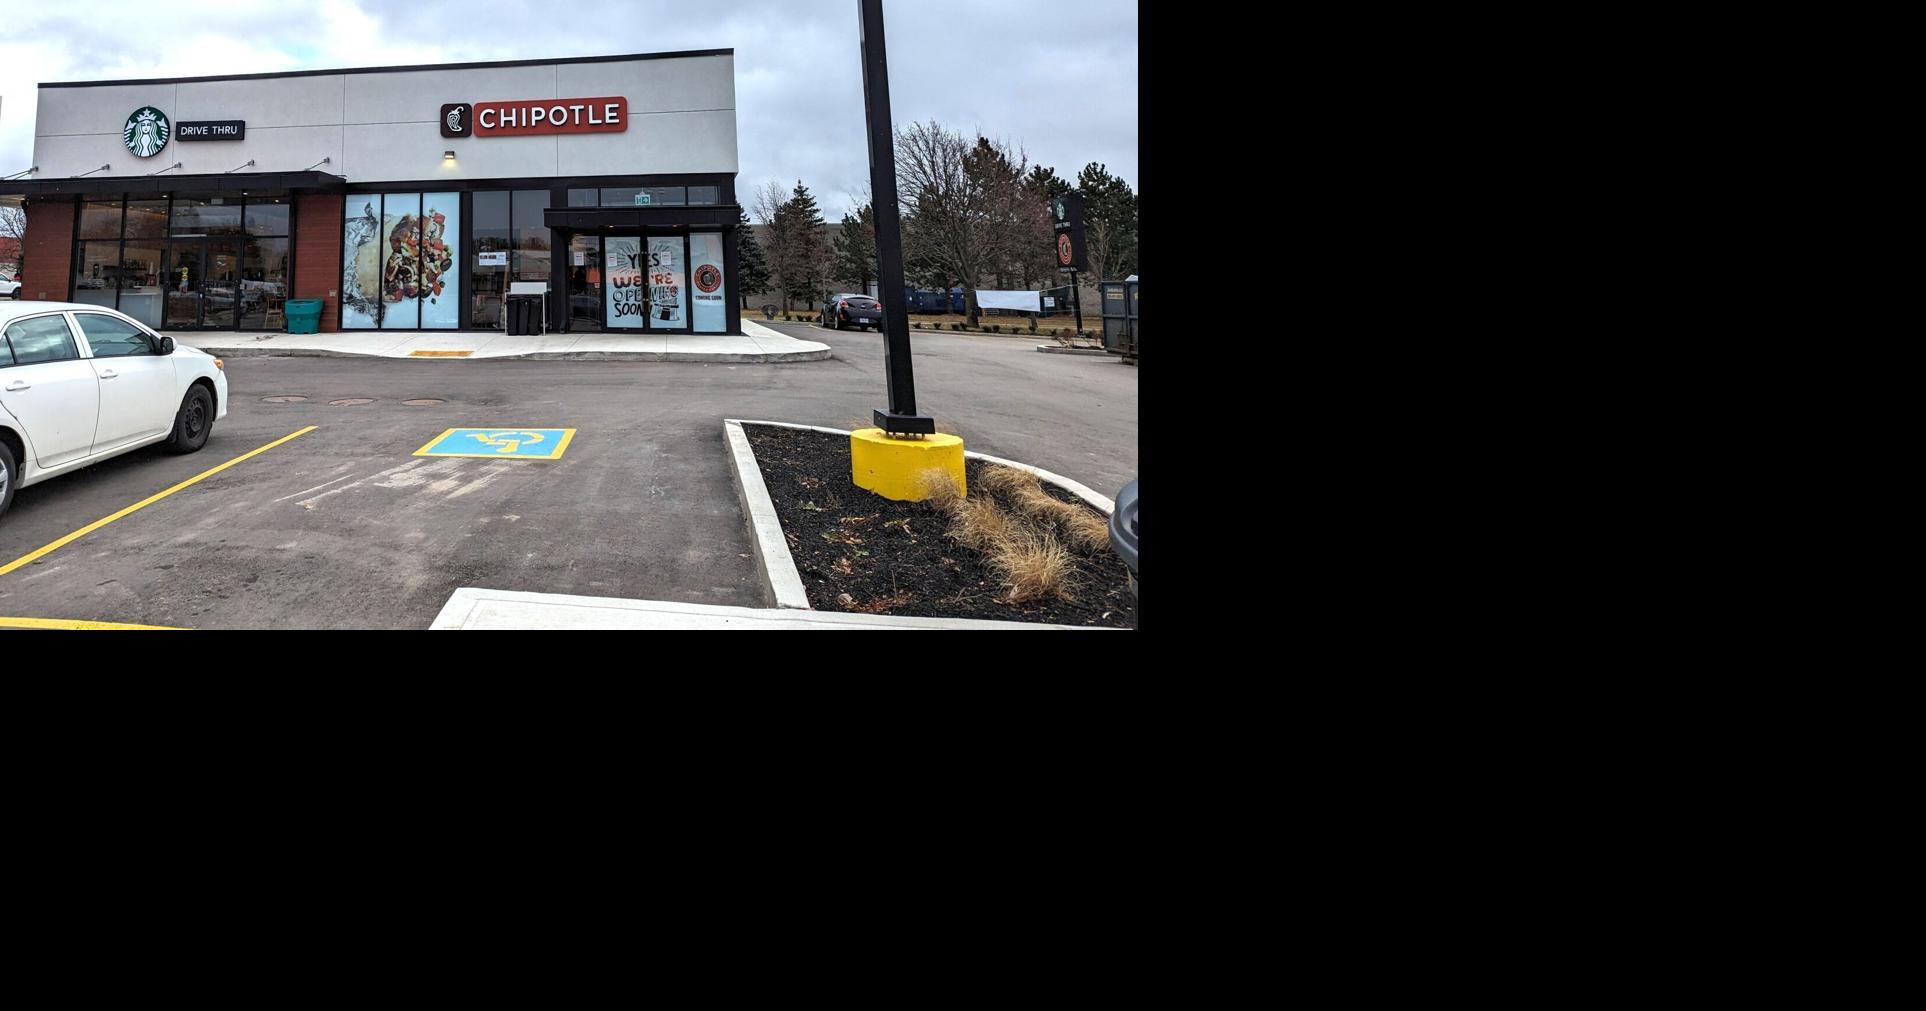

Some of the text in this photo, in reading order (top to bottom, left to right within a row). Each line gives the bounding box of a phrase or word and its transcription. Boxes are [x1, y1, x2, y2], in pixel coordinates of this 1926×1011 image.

[479, 103, 620, 129] CHIPOTLE
[180, 125, 238, 136] DRIVE THRU
